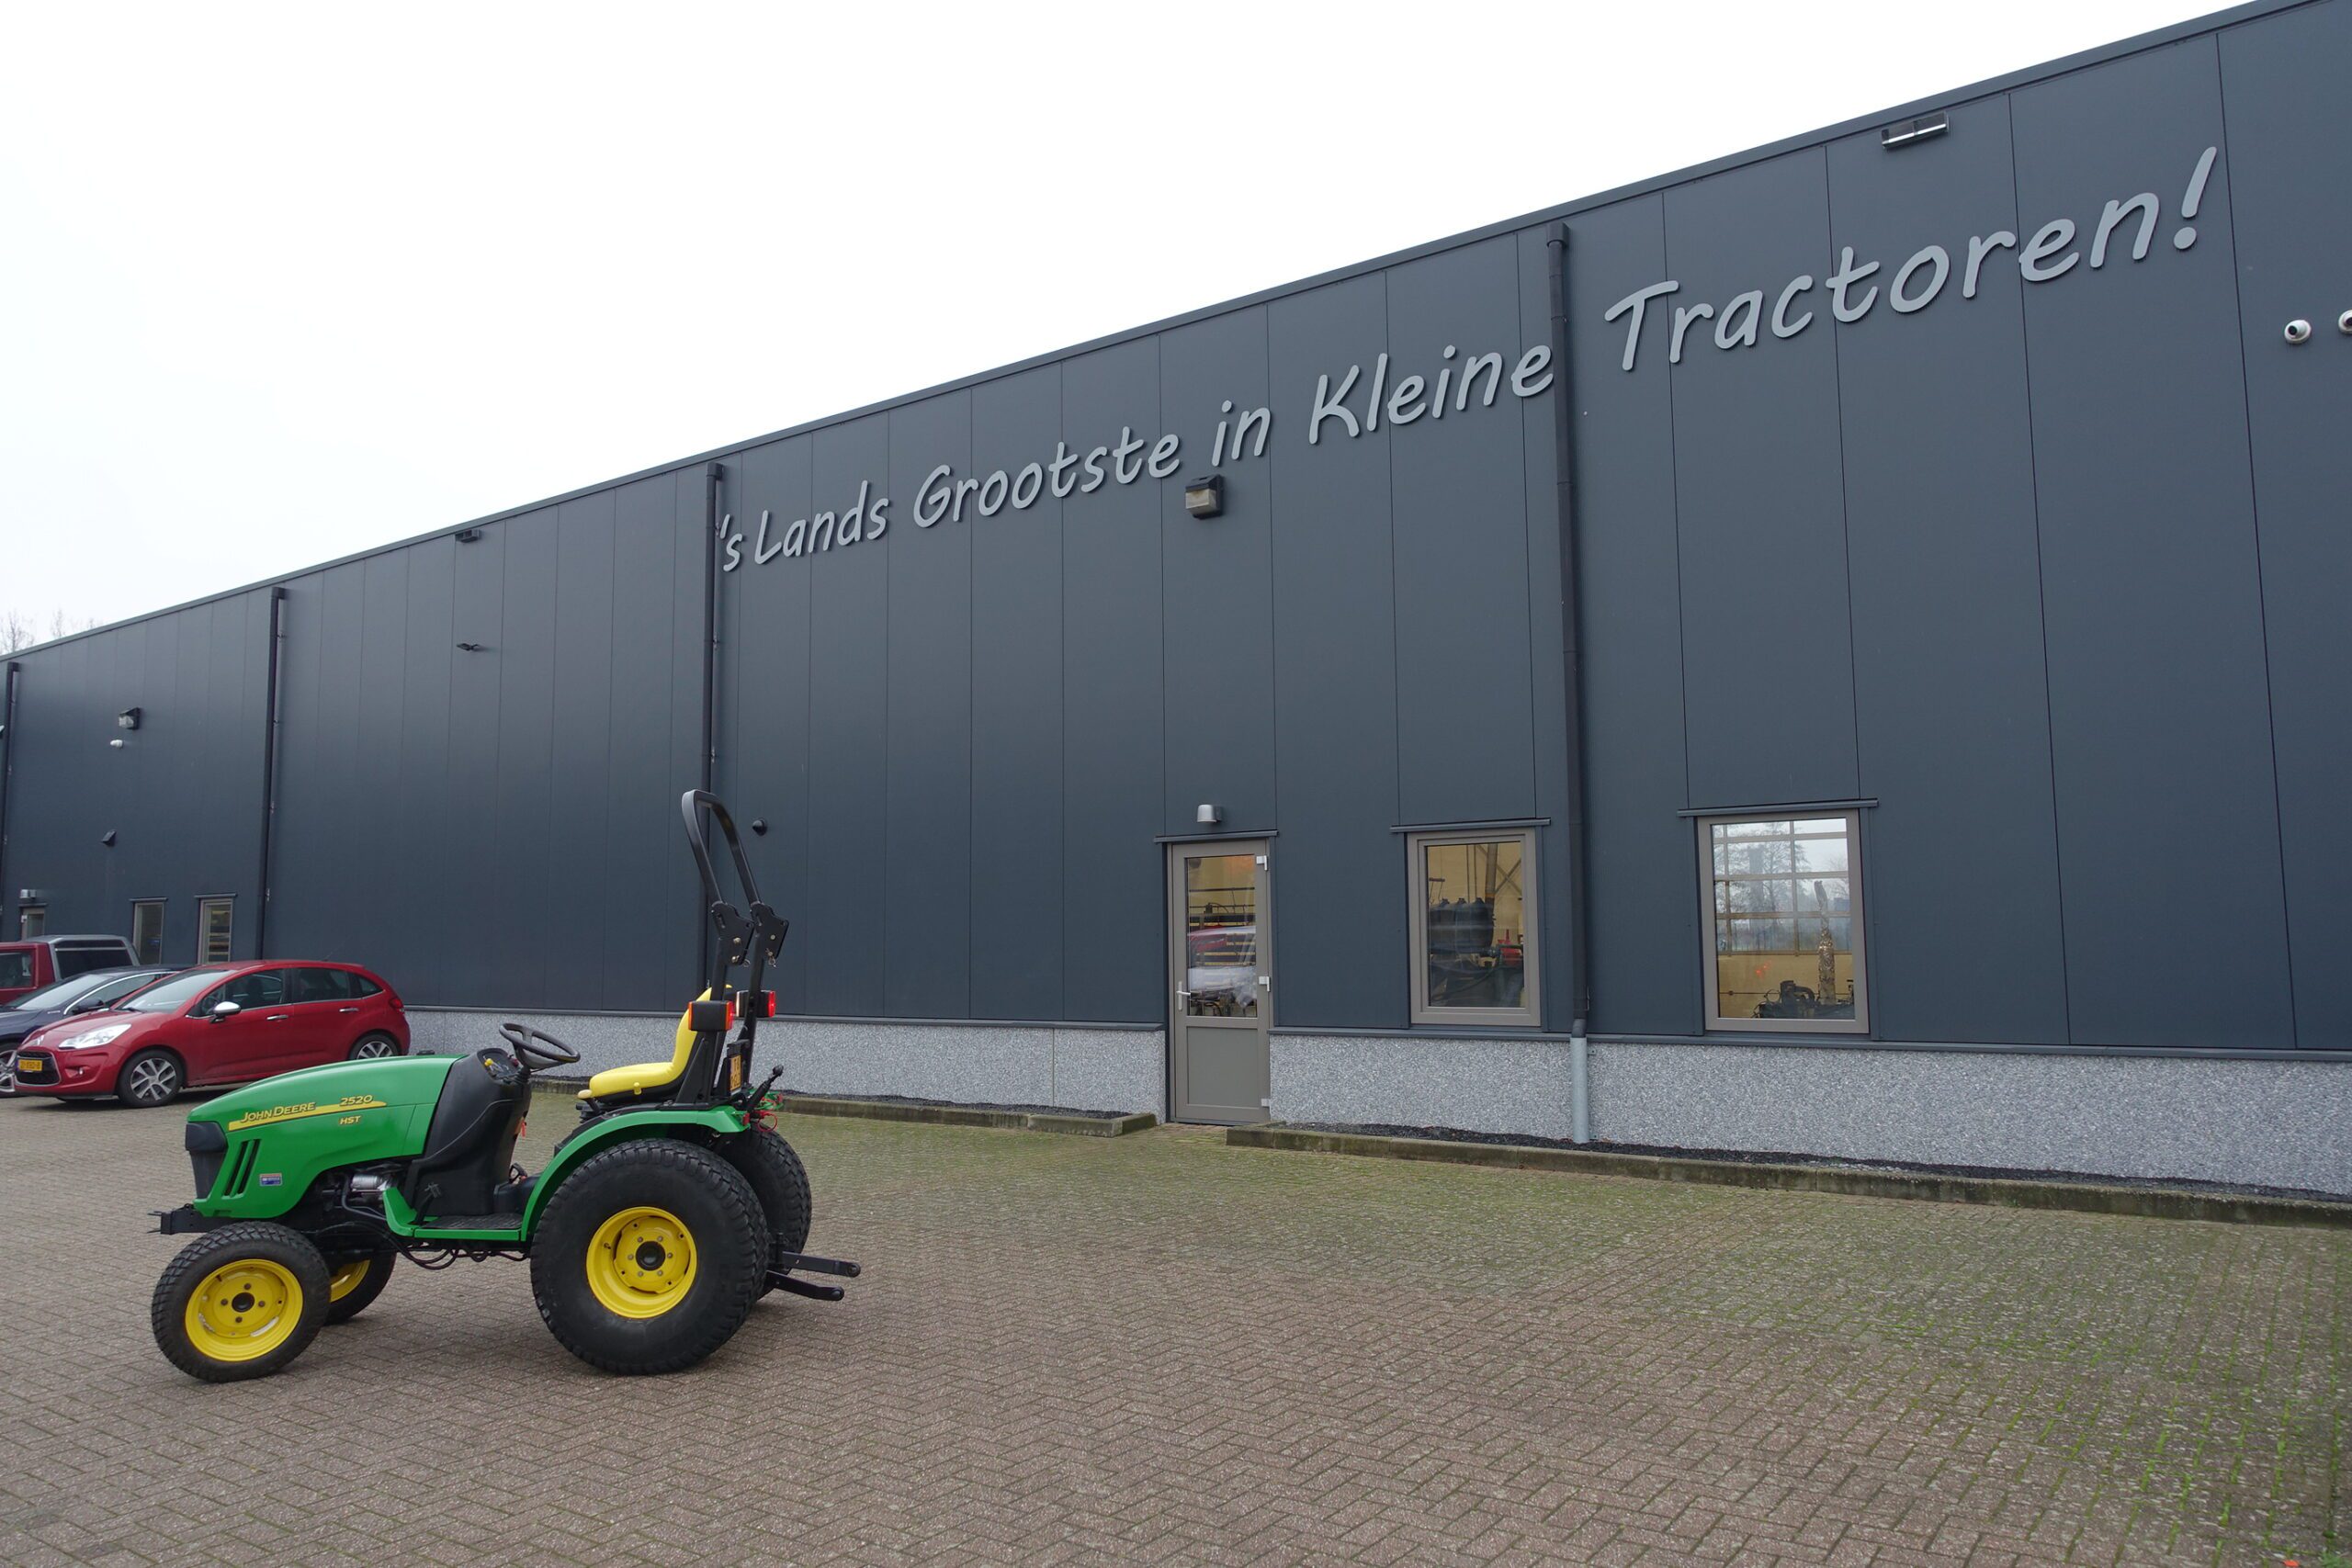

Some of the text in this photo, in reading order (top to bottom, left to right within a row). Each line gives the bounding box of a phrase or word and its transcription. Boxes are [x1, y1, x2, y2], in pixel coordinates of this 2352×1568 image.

[720, 146, 2217, 571] 's Lands Grootste in Kleine Tractoren!
[340, 1095, 373, 1106] 2520
[241, 1102, 316, 1122] JOHN DEERE
[339, 1116, 361, 1125] HST
